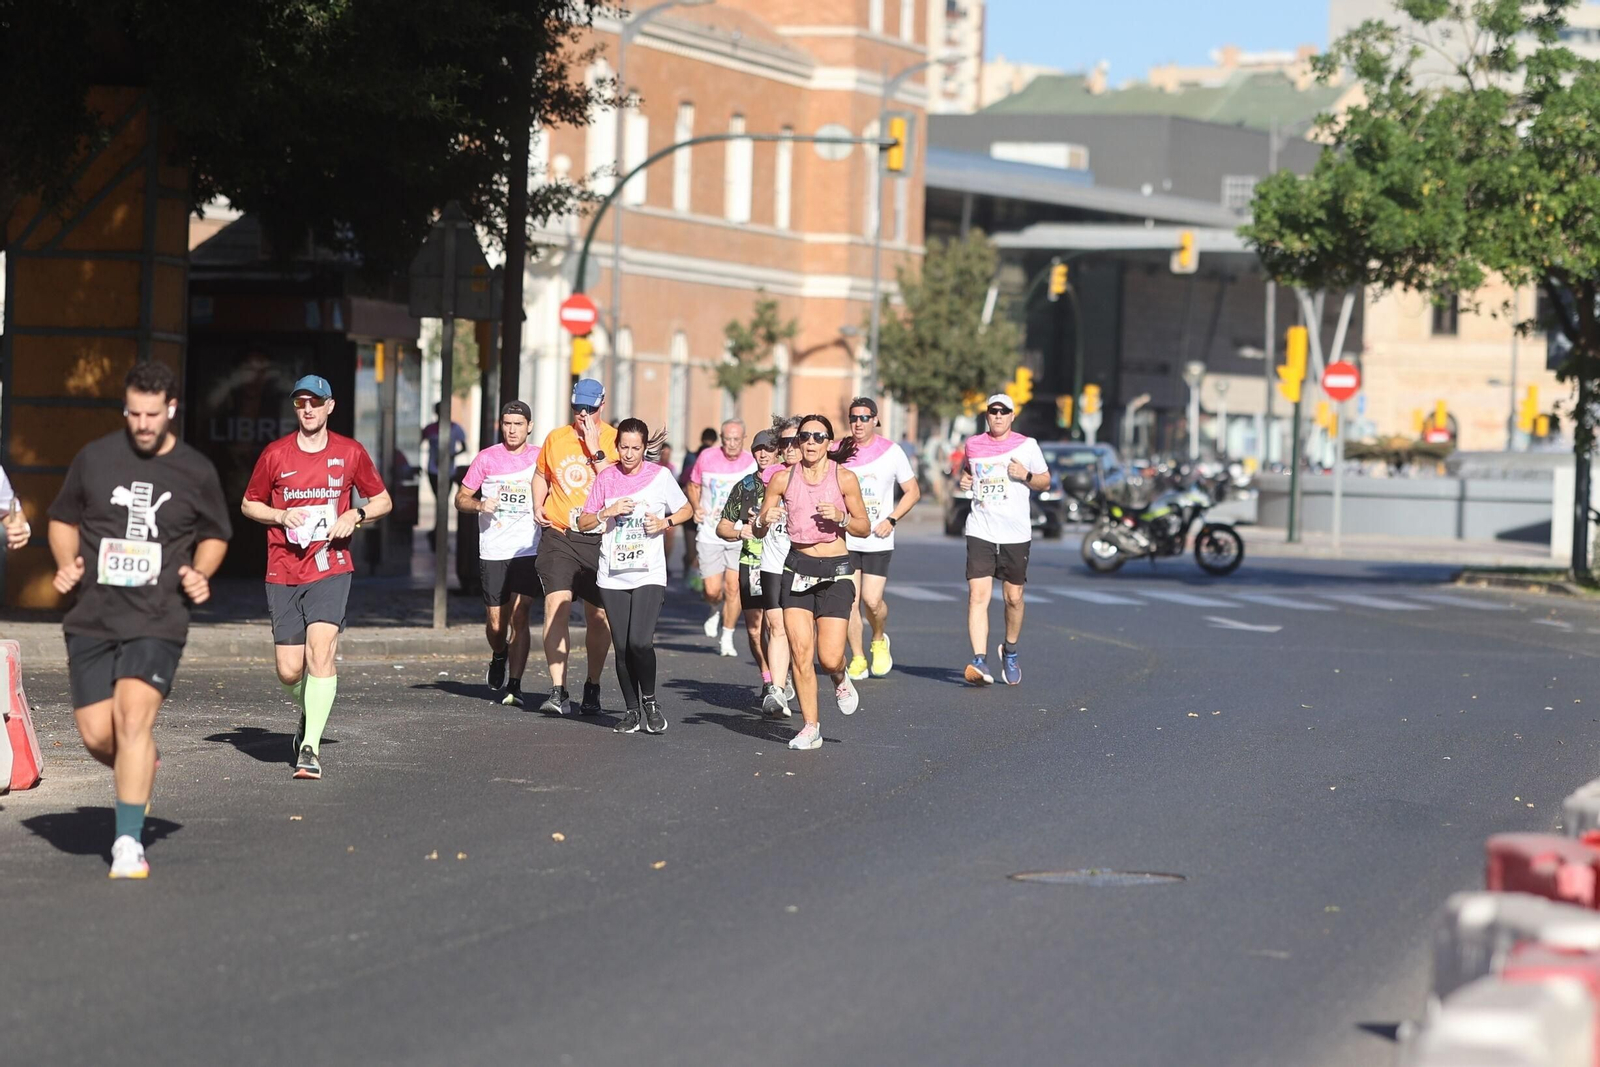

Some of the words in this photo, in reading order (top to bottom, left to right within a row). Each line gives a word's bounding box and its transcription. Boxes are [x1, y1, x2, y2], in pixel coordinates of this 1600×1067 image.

[982, 485, 1004, 494] 373
[500, 493, 526, 504] 362
[617, 550, 645, 562] 348
[108, 556, 150, 573] 380
